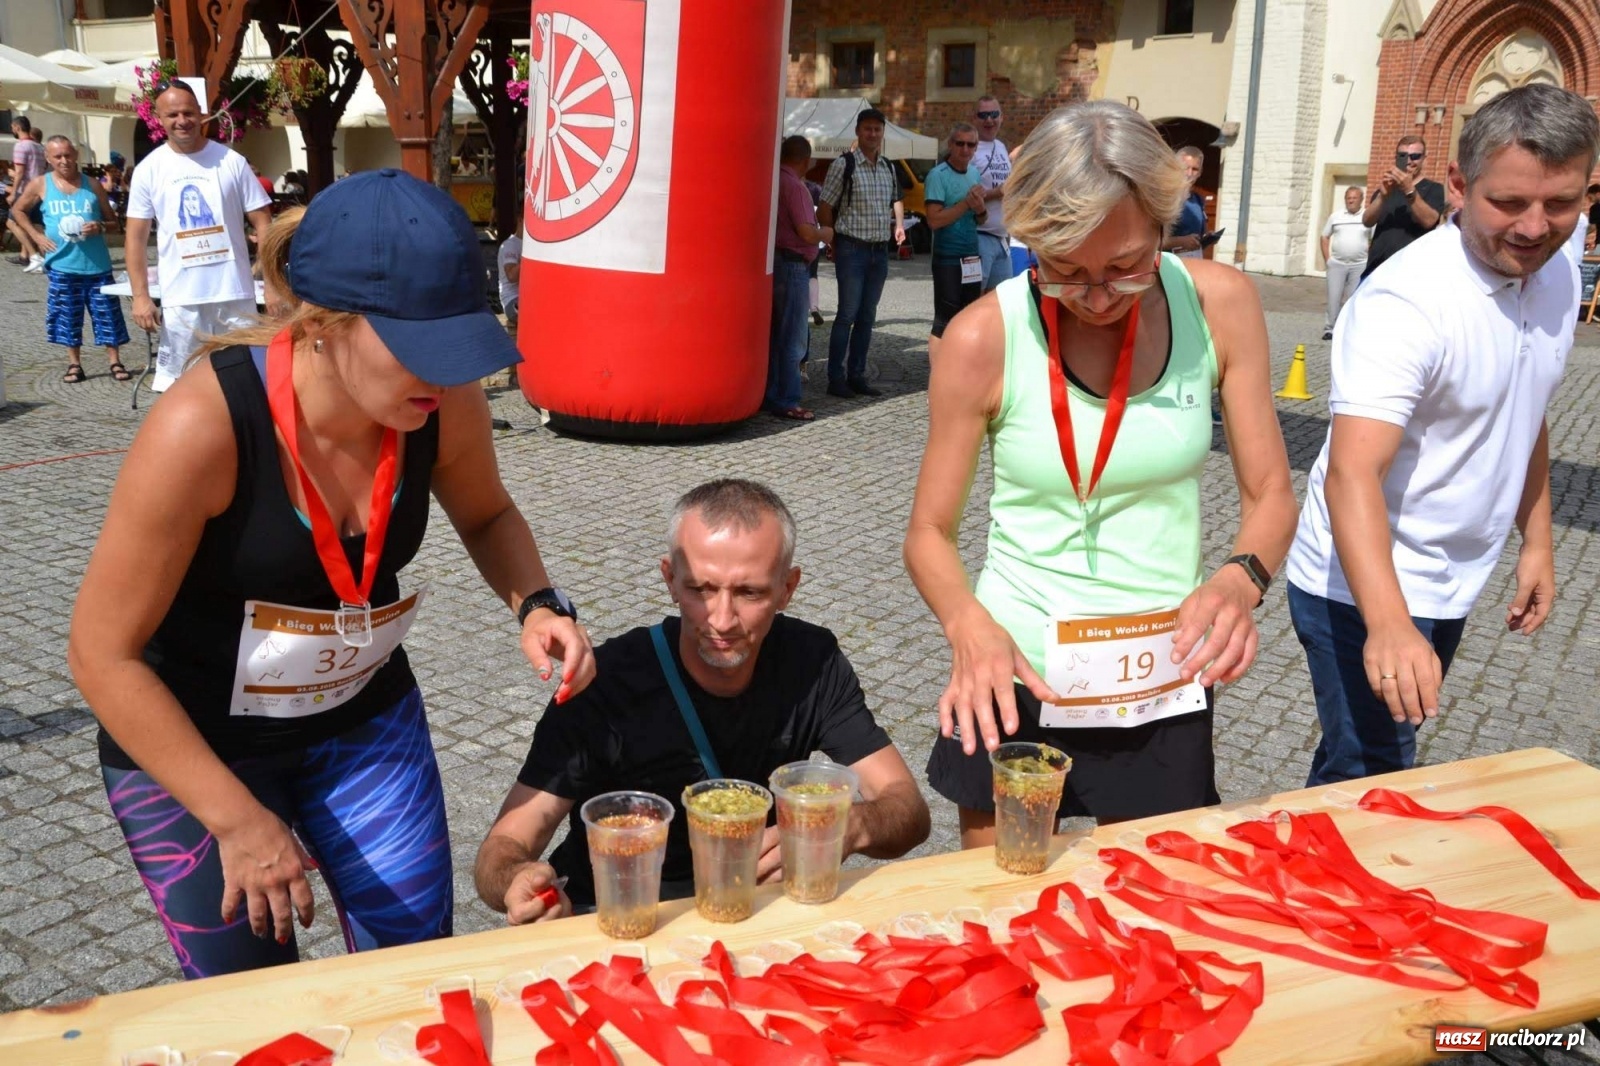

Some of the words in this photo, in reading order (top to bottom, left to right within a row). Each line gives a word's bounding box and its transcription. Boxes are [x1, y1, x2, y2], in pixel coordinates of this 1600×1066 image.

[48, 198, 93, 215] UCLA
[197, 239, 210, 249] 44
[286, 619, 315, 631] Bieg
[1086, 628, 1112, 638] Bieg
[1115, 624, 1149, 635] Wokół
[1151, 617, 1177, 631] Komi
[314, 646, 360, 674] 32
[1116, 651, 1155, 683] 19
